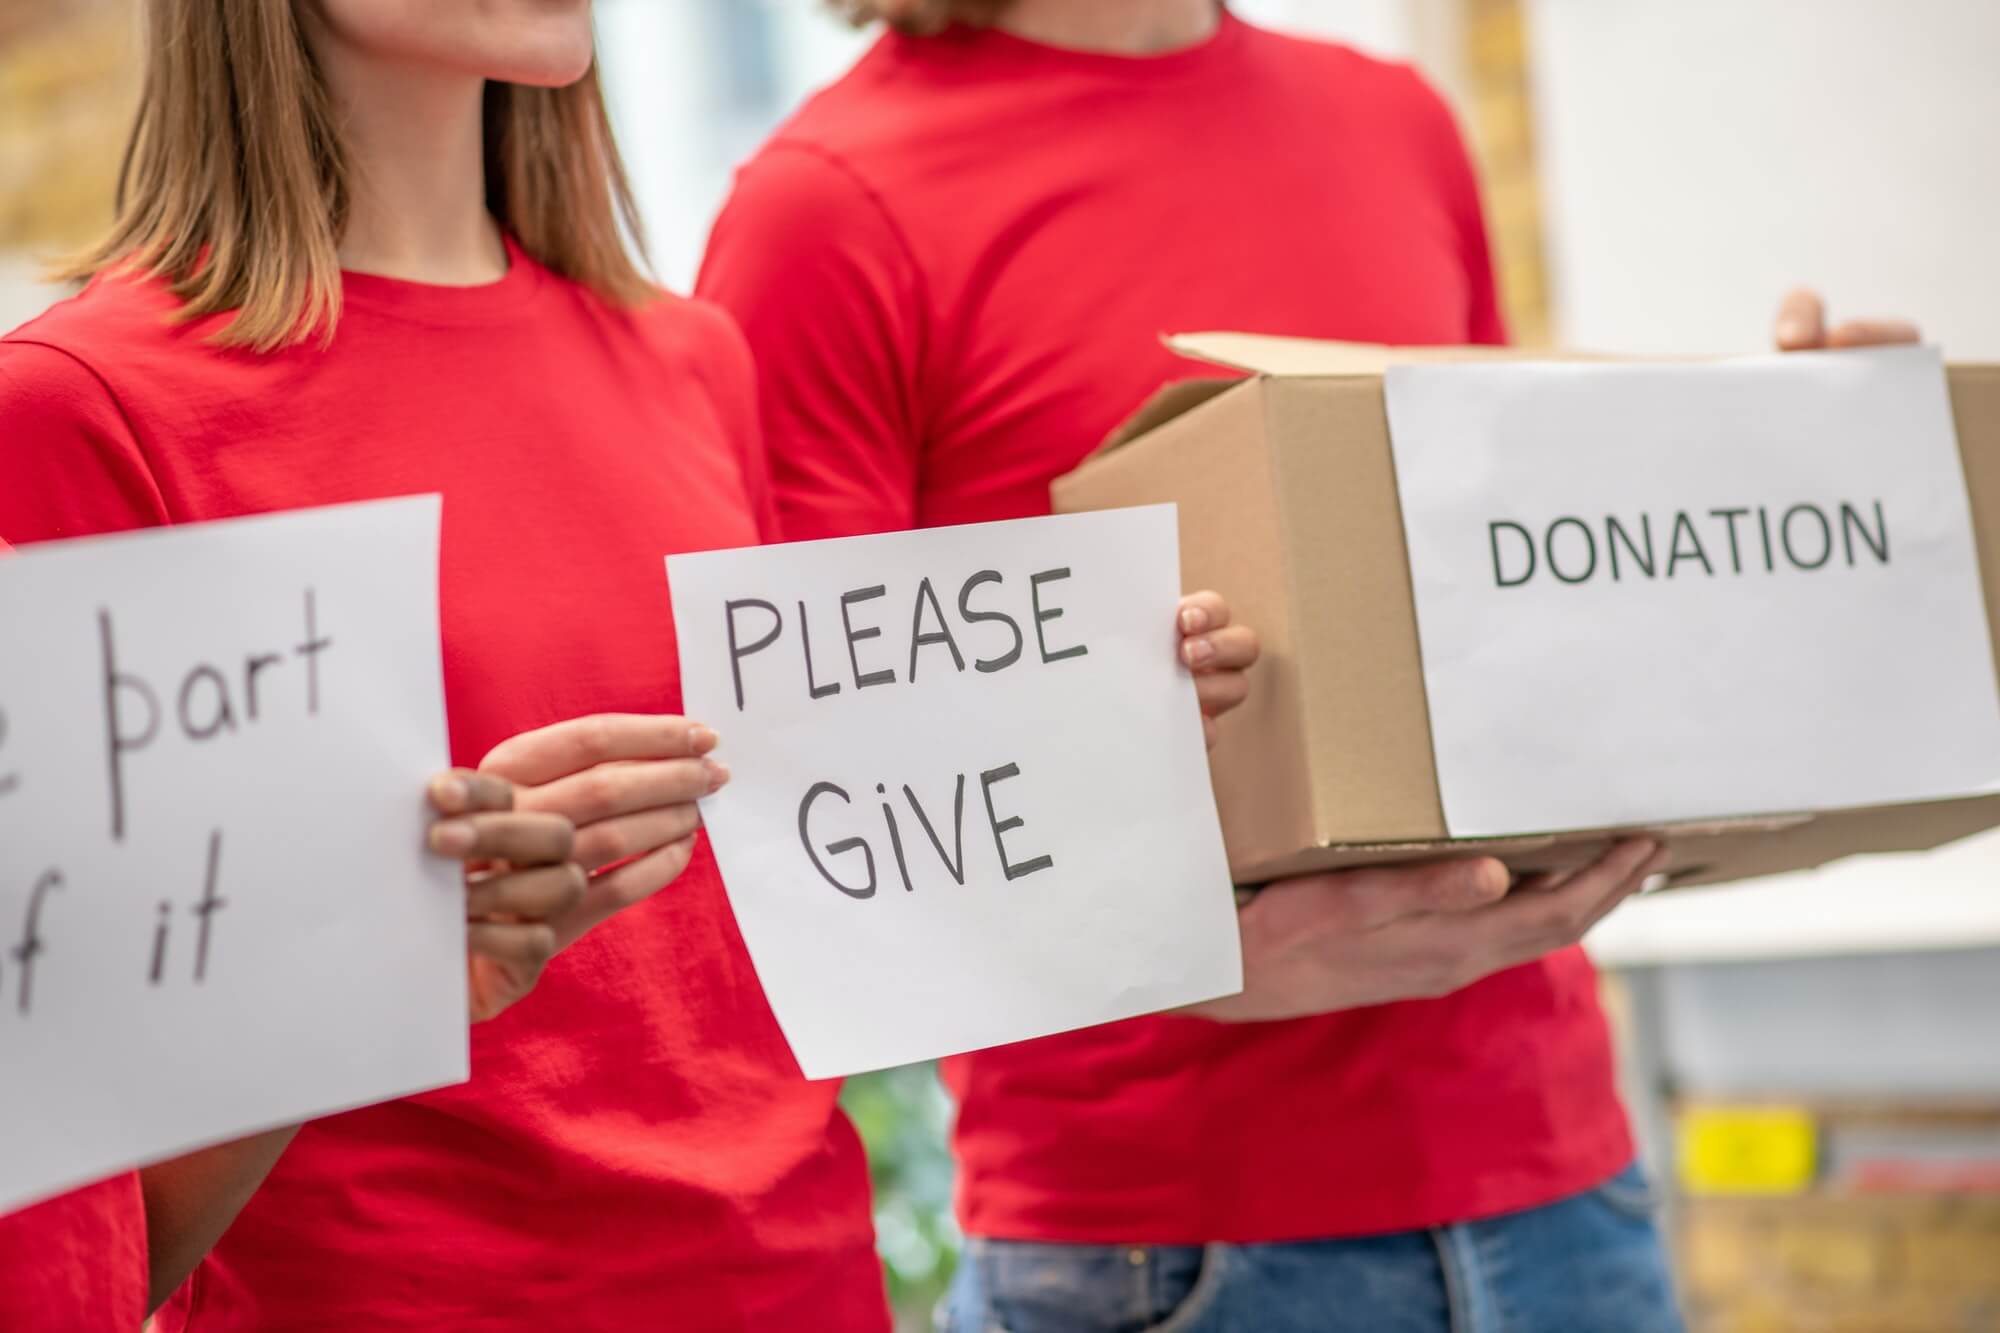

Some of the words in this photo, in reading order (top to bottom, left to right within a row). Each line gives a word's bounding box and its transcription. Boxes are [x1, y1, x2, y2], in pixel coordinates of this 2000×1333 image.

[1488, 499, 1892, 588] DONATION
[97, 588, 332, 844] part
[725, 567, 1089, 712] PLEASE
[0, 867, 64, 1015] f
[147, 829, 227, 985] it
